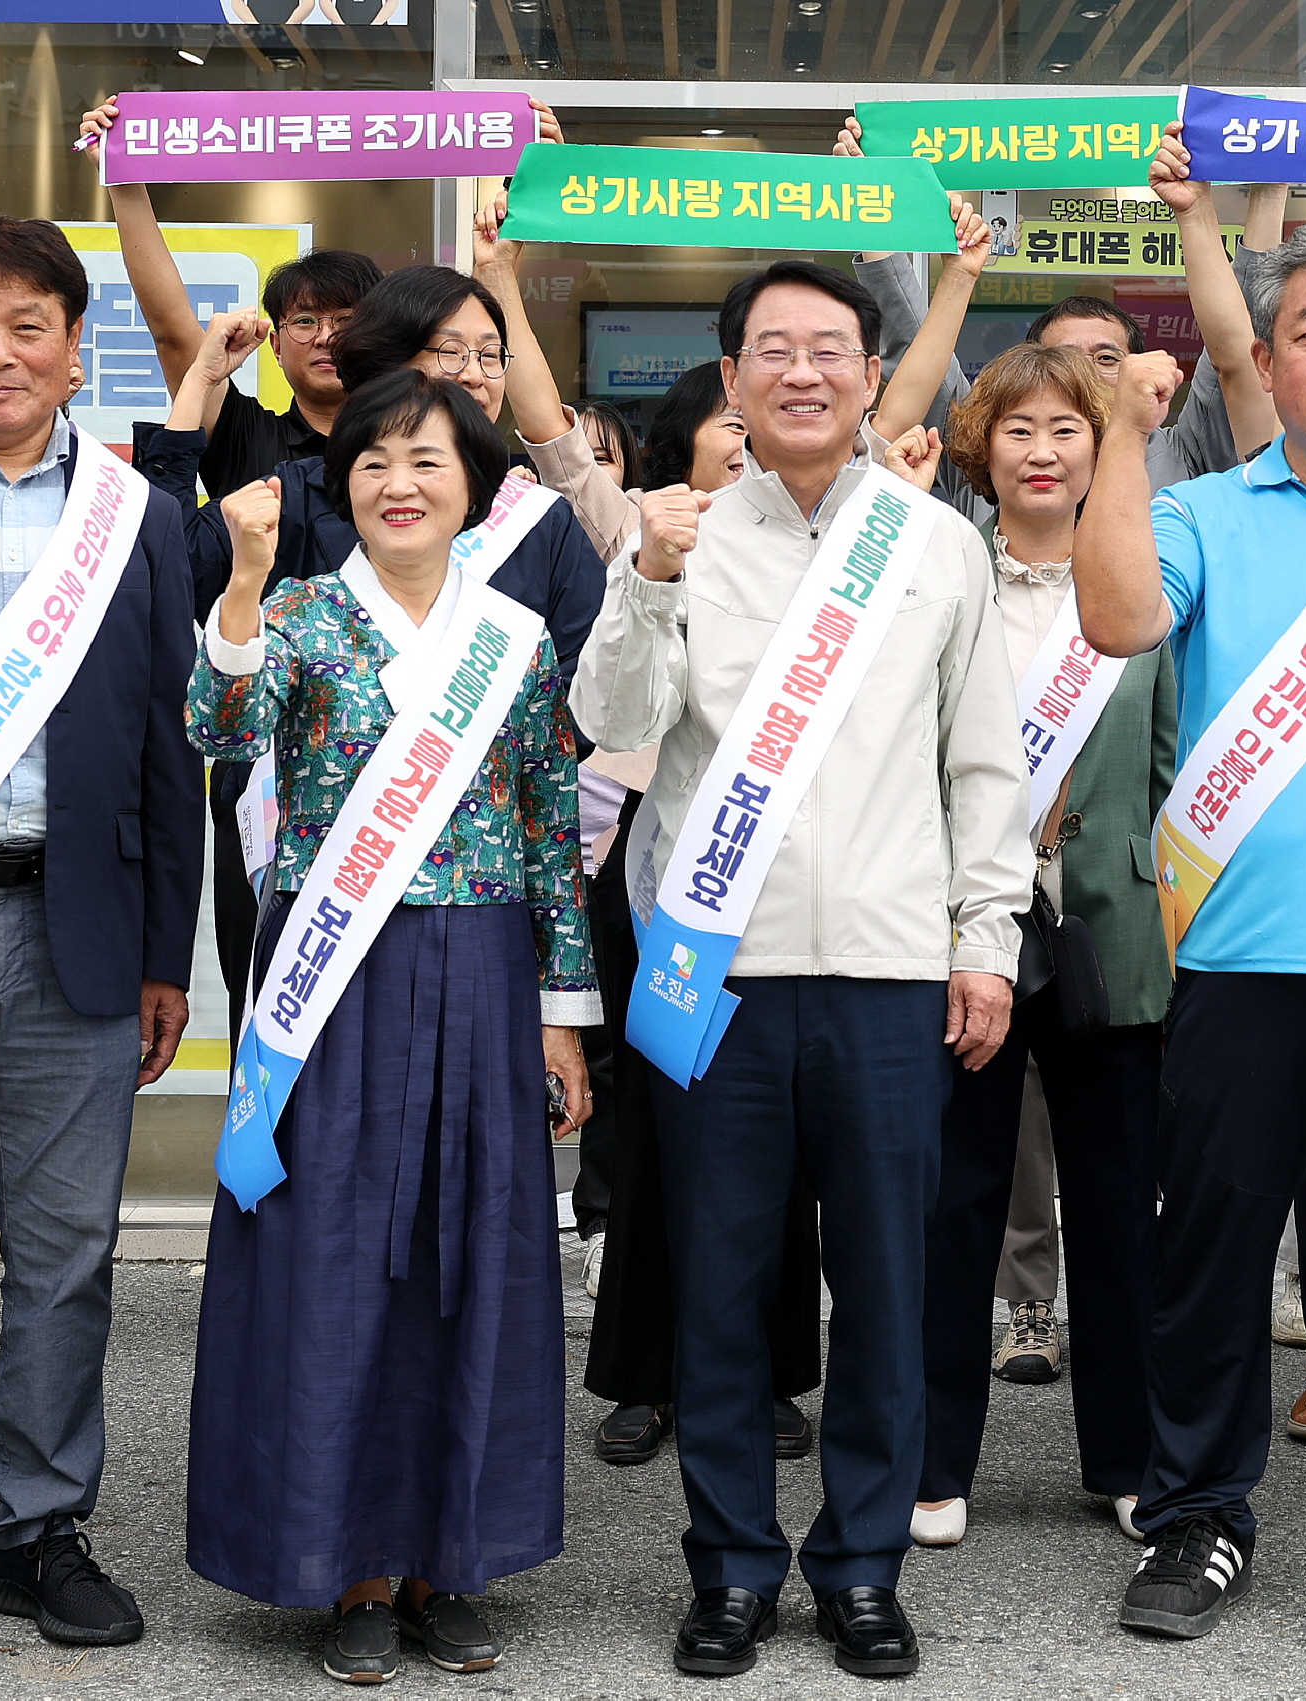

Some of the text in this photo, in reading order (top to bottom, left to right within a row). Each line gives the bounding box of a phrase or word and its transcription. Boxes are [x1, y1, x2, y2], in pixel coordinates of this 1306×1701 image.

[125, 112, 513, 155] 민생소비쿠폰 조기사용
[913, 125, 1058, 162] 상가사랑
[1223, 118, 1300, 153] 상가
[562, 176, 894, 222] 상가사랑 지역사랑
[1050, 200, 1175, 223] 무엇이든 물어보
[1025, 230, 1129, 265] 휴대폰
[74, 464, 131, 580] 소상공인이
[28, 575, 85, 656] 웃어야
[431, 617, 507, 738] 풍요롭고
[685, 488, 911, 912] 풍요롭고 즐거운 명절 보내세요
[372, 727, 455, 832] 즐거운
[1186, 728, 1275, 839] 이용하세요
[333, 824, 395, 903] 명절
[270, 895, 352, 1036] 보내세요
[652, 968, 698, 1007] 강진군
[648, 981, 695, 1015] GANGJINCITY
